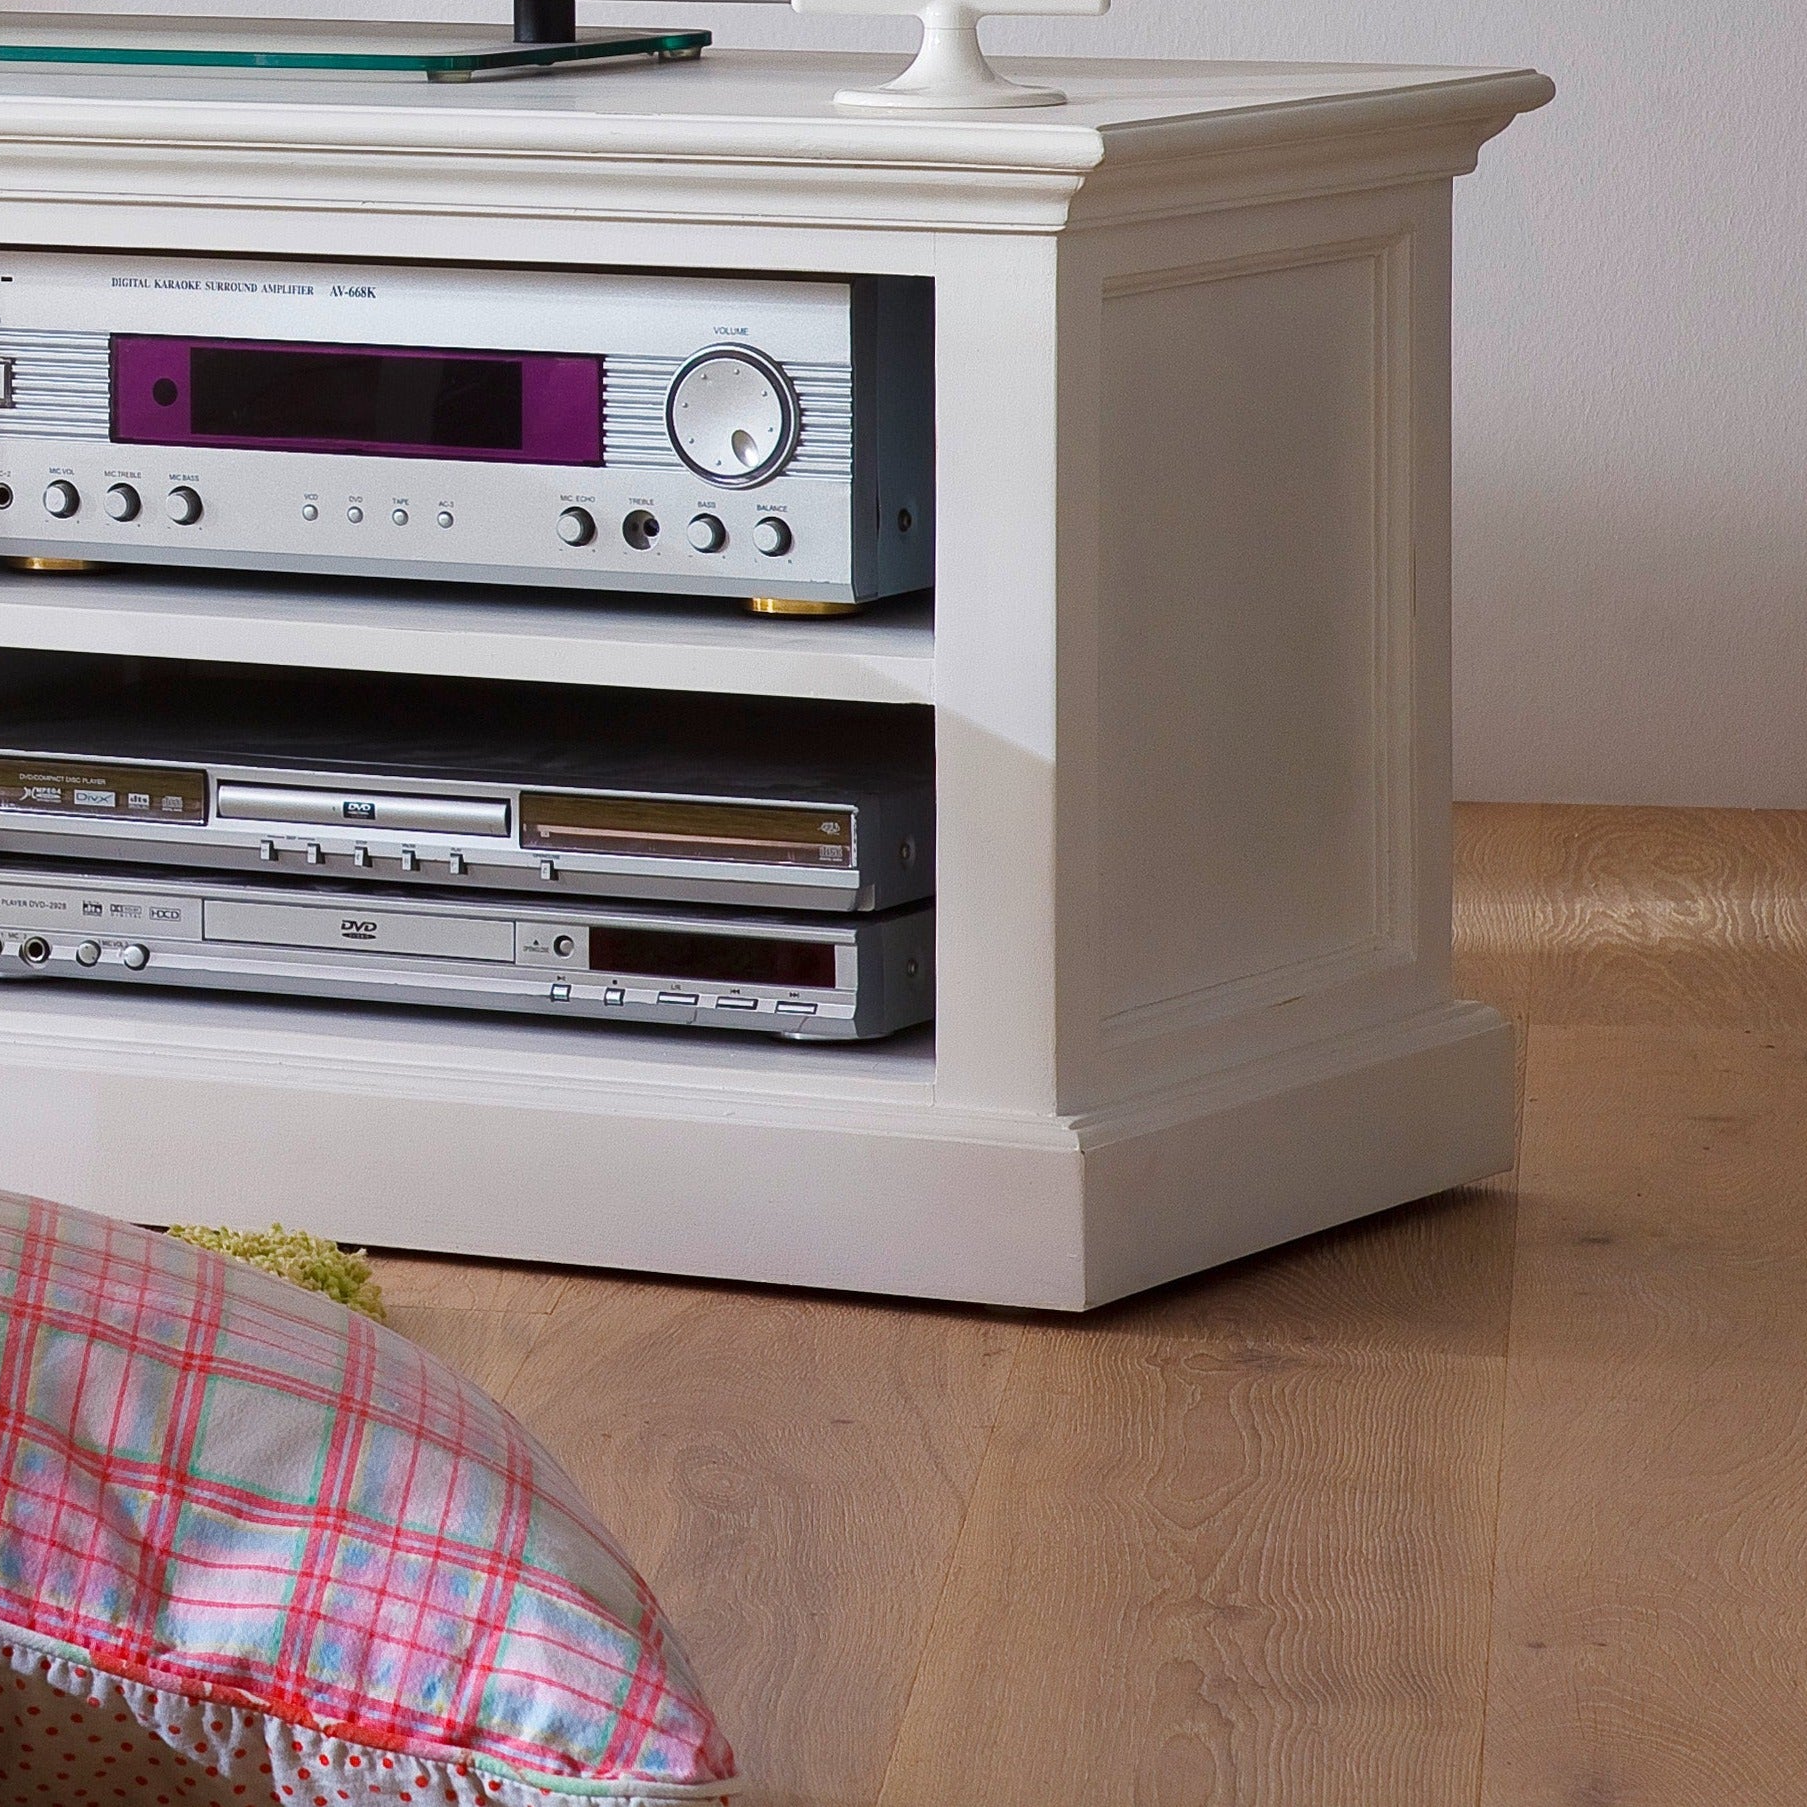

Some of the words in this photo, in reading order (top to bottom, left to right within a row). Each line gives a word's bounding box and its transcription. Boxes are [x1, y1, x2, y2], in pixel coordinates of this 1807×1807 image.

[111, 277, 151, 289] DIGITAL
[154, 279, 202, 291] KARAOKE
[205, 280, 258, 293] SURROUND
[260, 283, 314, 296] AMPLIFIER
[330, 286, 377, 299] AV-668K
[713, 326, 750, 336] VOLUME
[628, 497, 655, 506] TREBLE
[697, 501, 716, 509] BASS
[756, 504, 788, 513] BALANCE
[82, 777, 107, 785] PLAYER
[348, 802, 372, 811] DVD
[1, 899, 28, 907] PLAYER
[341, 919, 378, 932] DVD
